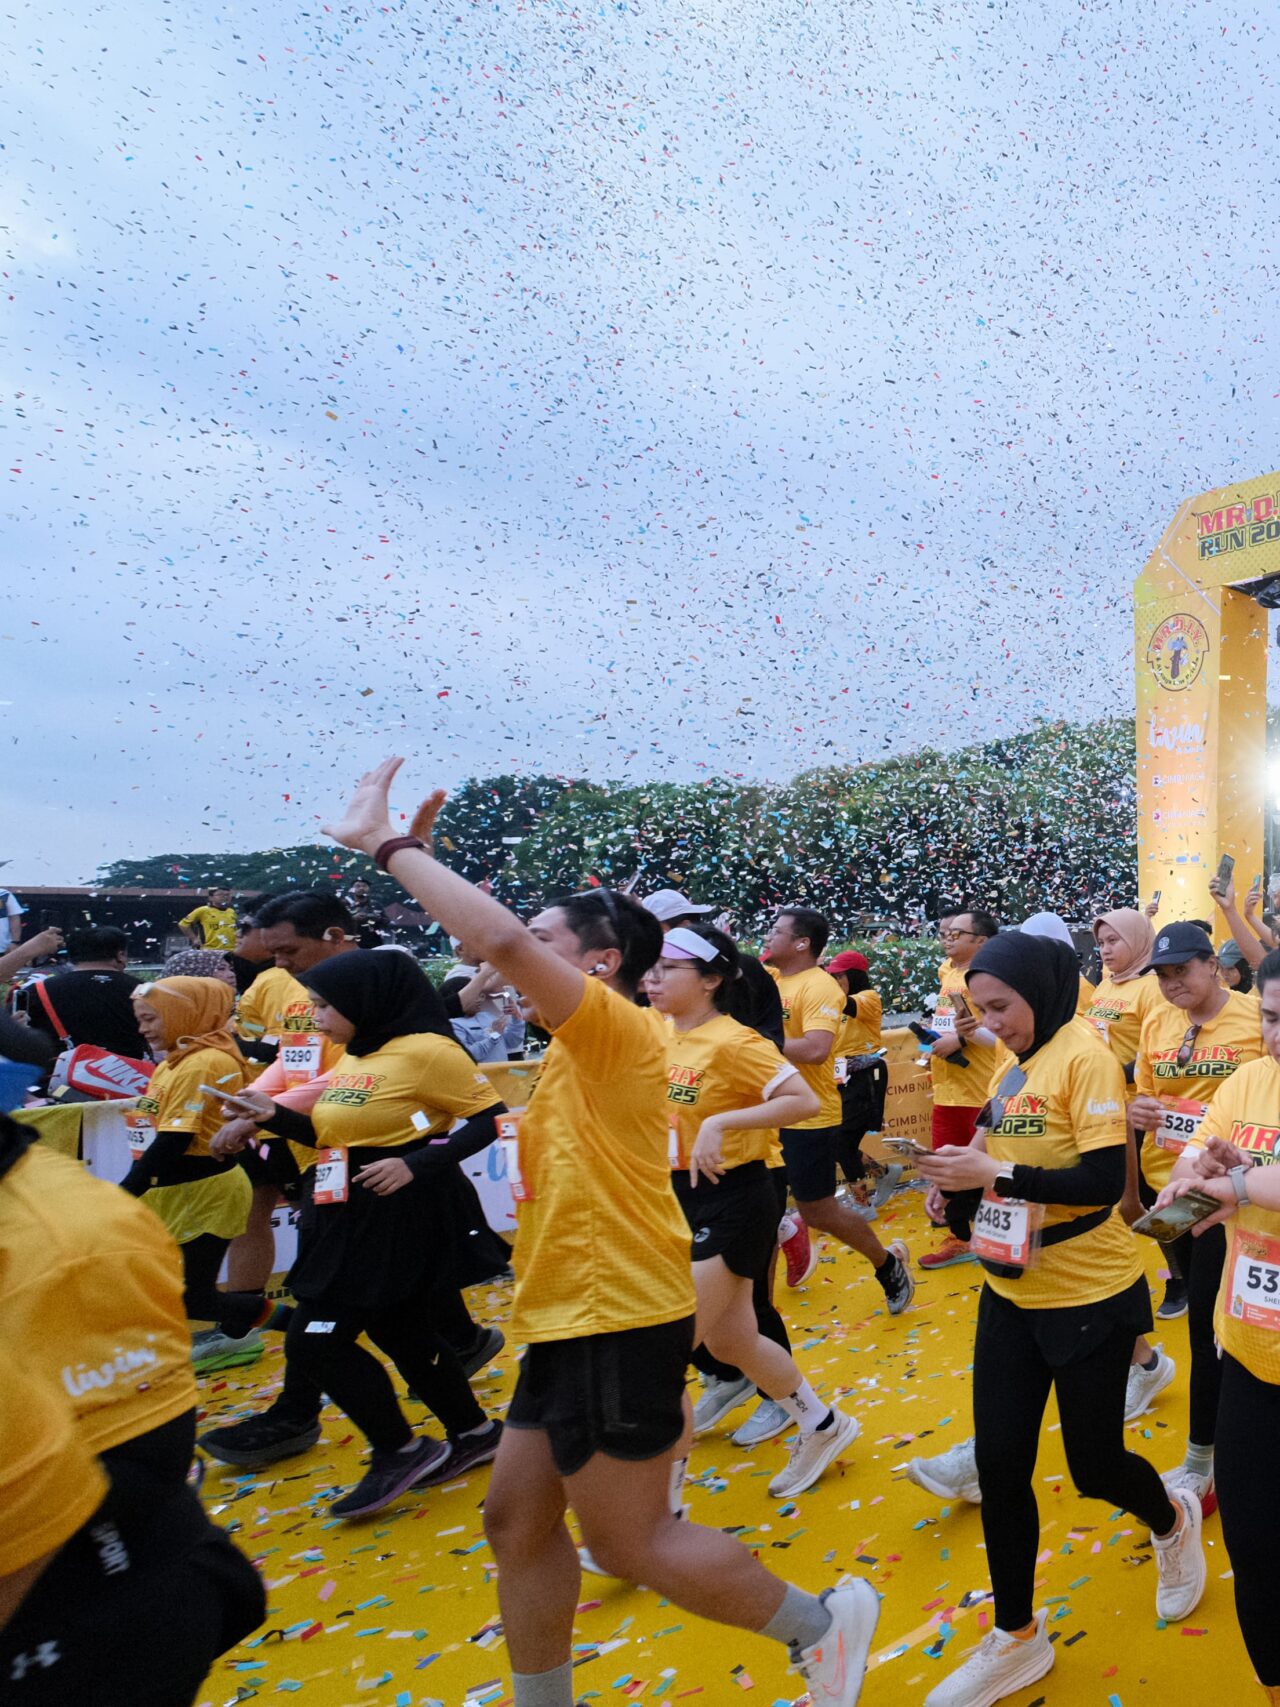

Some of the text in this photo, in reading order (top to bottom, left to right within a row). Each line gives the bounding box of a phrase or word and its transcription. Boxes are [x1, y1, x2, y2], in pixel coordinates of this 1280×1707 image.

[1199, 503, 1246, 536] MR
[1200, 530, 1246, 560] RUN
[934, 1017, 951, 1027] 5061
[284, 1050, 312, 1063] 5290
[887, 1083, 915, 1096] CIMB
[888, 1114, 917, 1128] CIMB
[977, 1204, 1012, 1232] 5483
